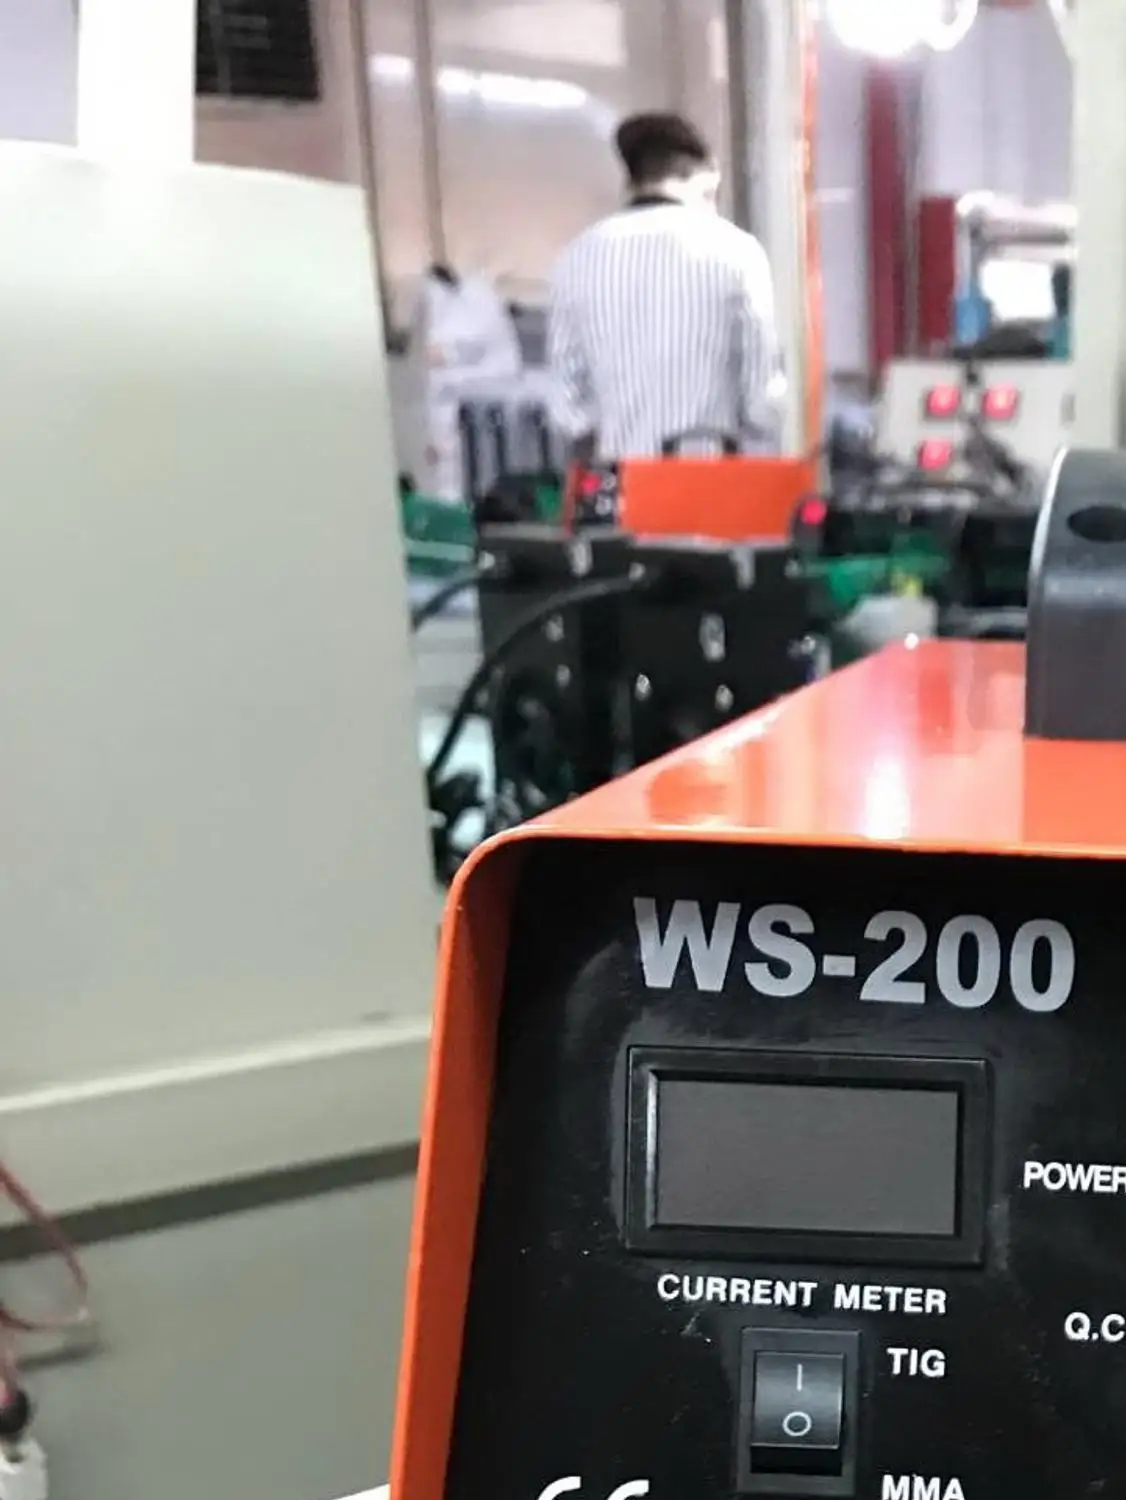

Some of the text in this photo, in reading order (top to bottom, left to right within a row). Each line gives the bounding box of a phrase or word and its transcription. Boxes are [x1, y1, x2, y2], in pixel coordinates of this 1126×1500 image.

[634, 897, 1076, 1013] WS-200
[656, 1273, 948, 1315] CURRENT METER
[1064, 1312, 1126, 1343] Q.C
[887, 1347, 946, 1378] TIG
